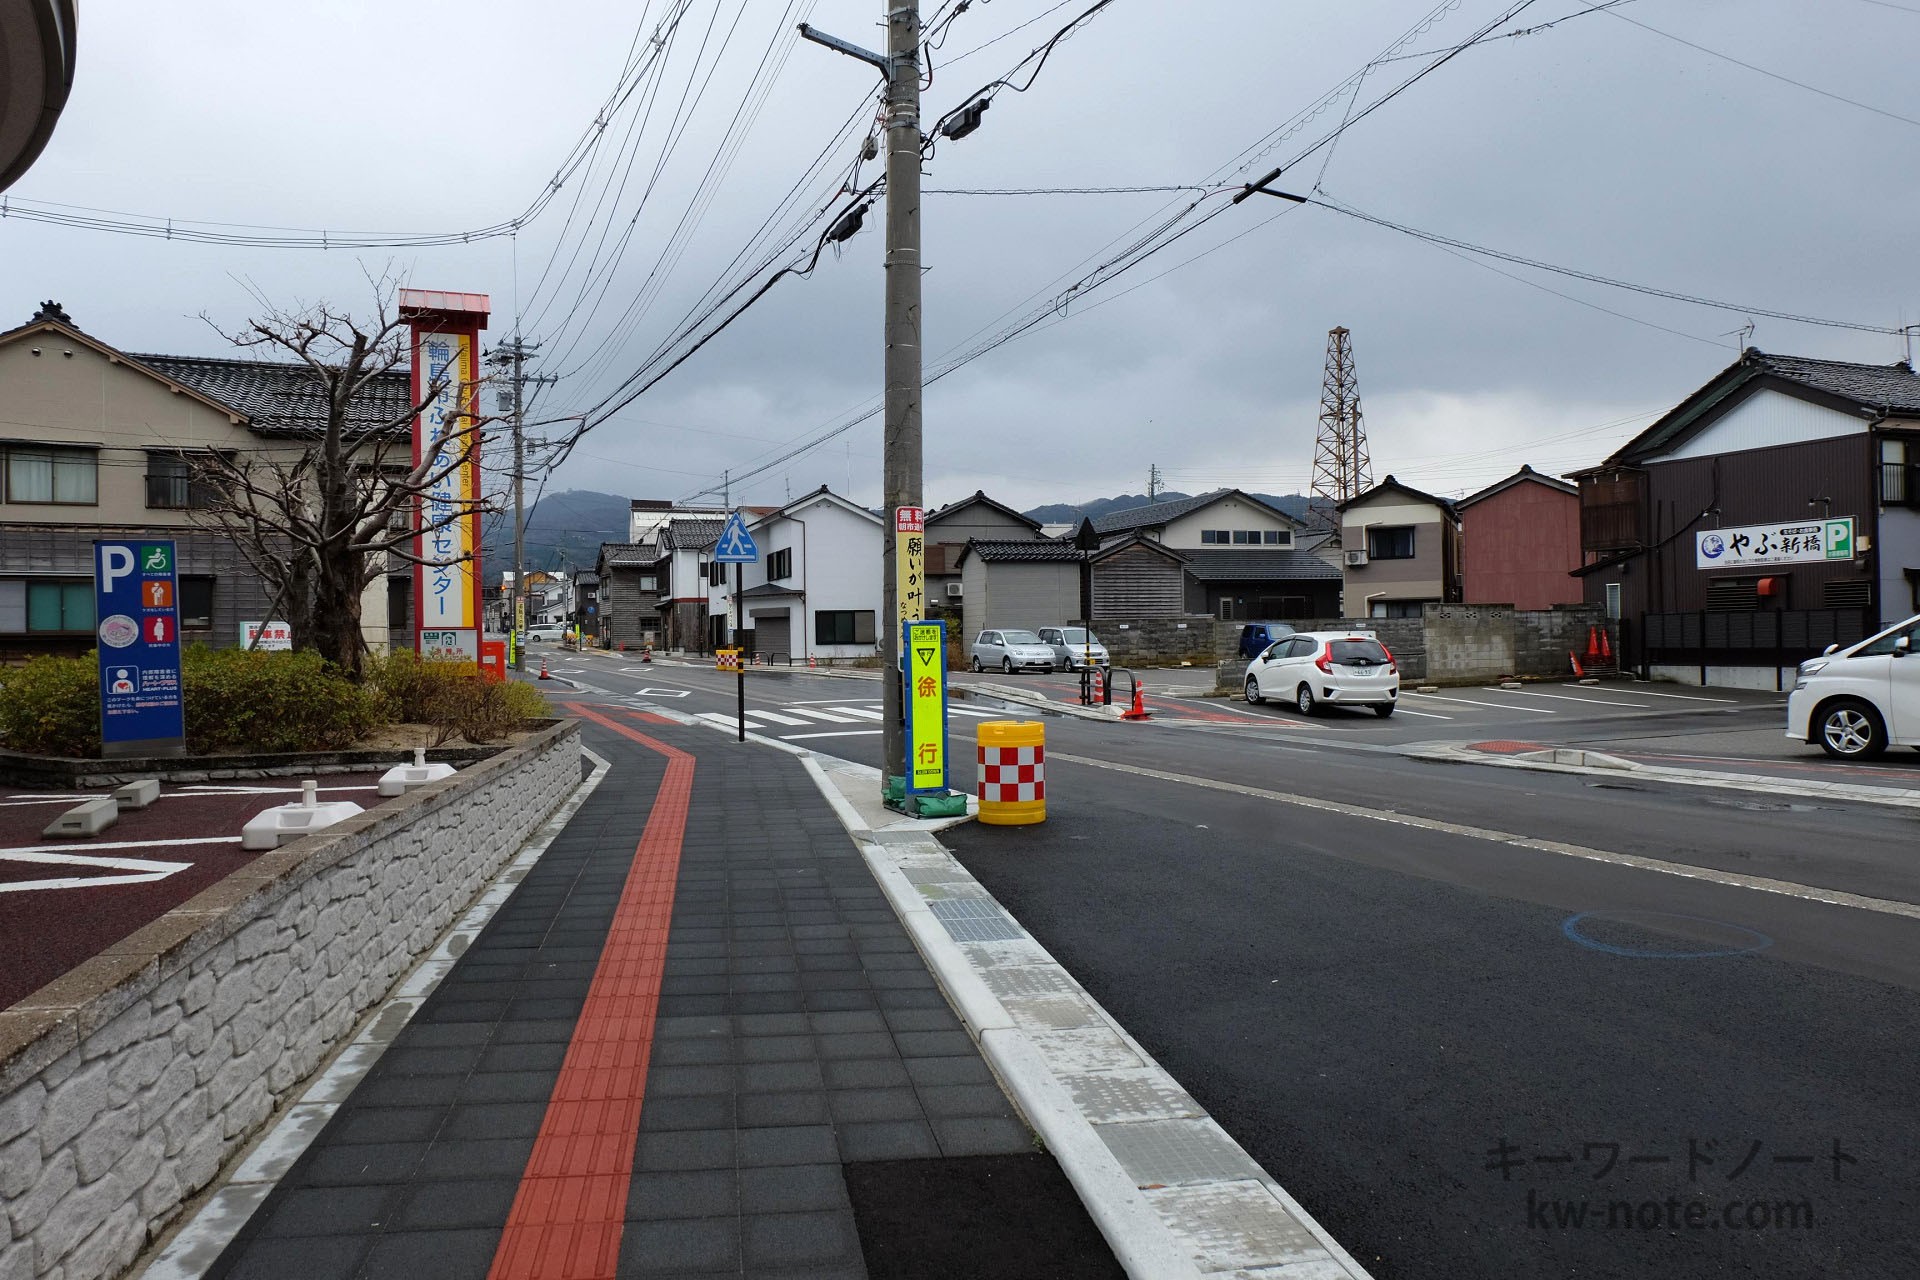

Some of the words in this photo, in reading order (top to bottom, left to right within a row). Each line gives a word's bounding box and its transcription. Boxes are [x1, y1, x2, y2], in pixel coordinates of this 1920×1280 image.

[1730, 532, 1821, 557] やぶ新橋
[1827, 523, 1848, 551] P
[101, 545, 135, 593] P
